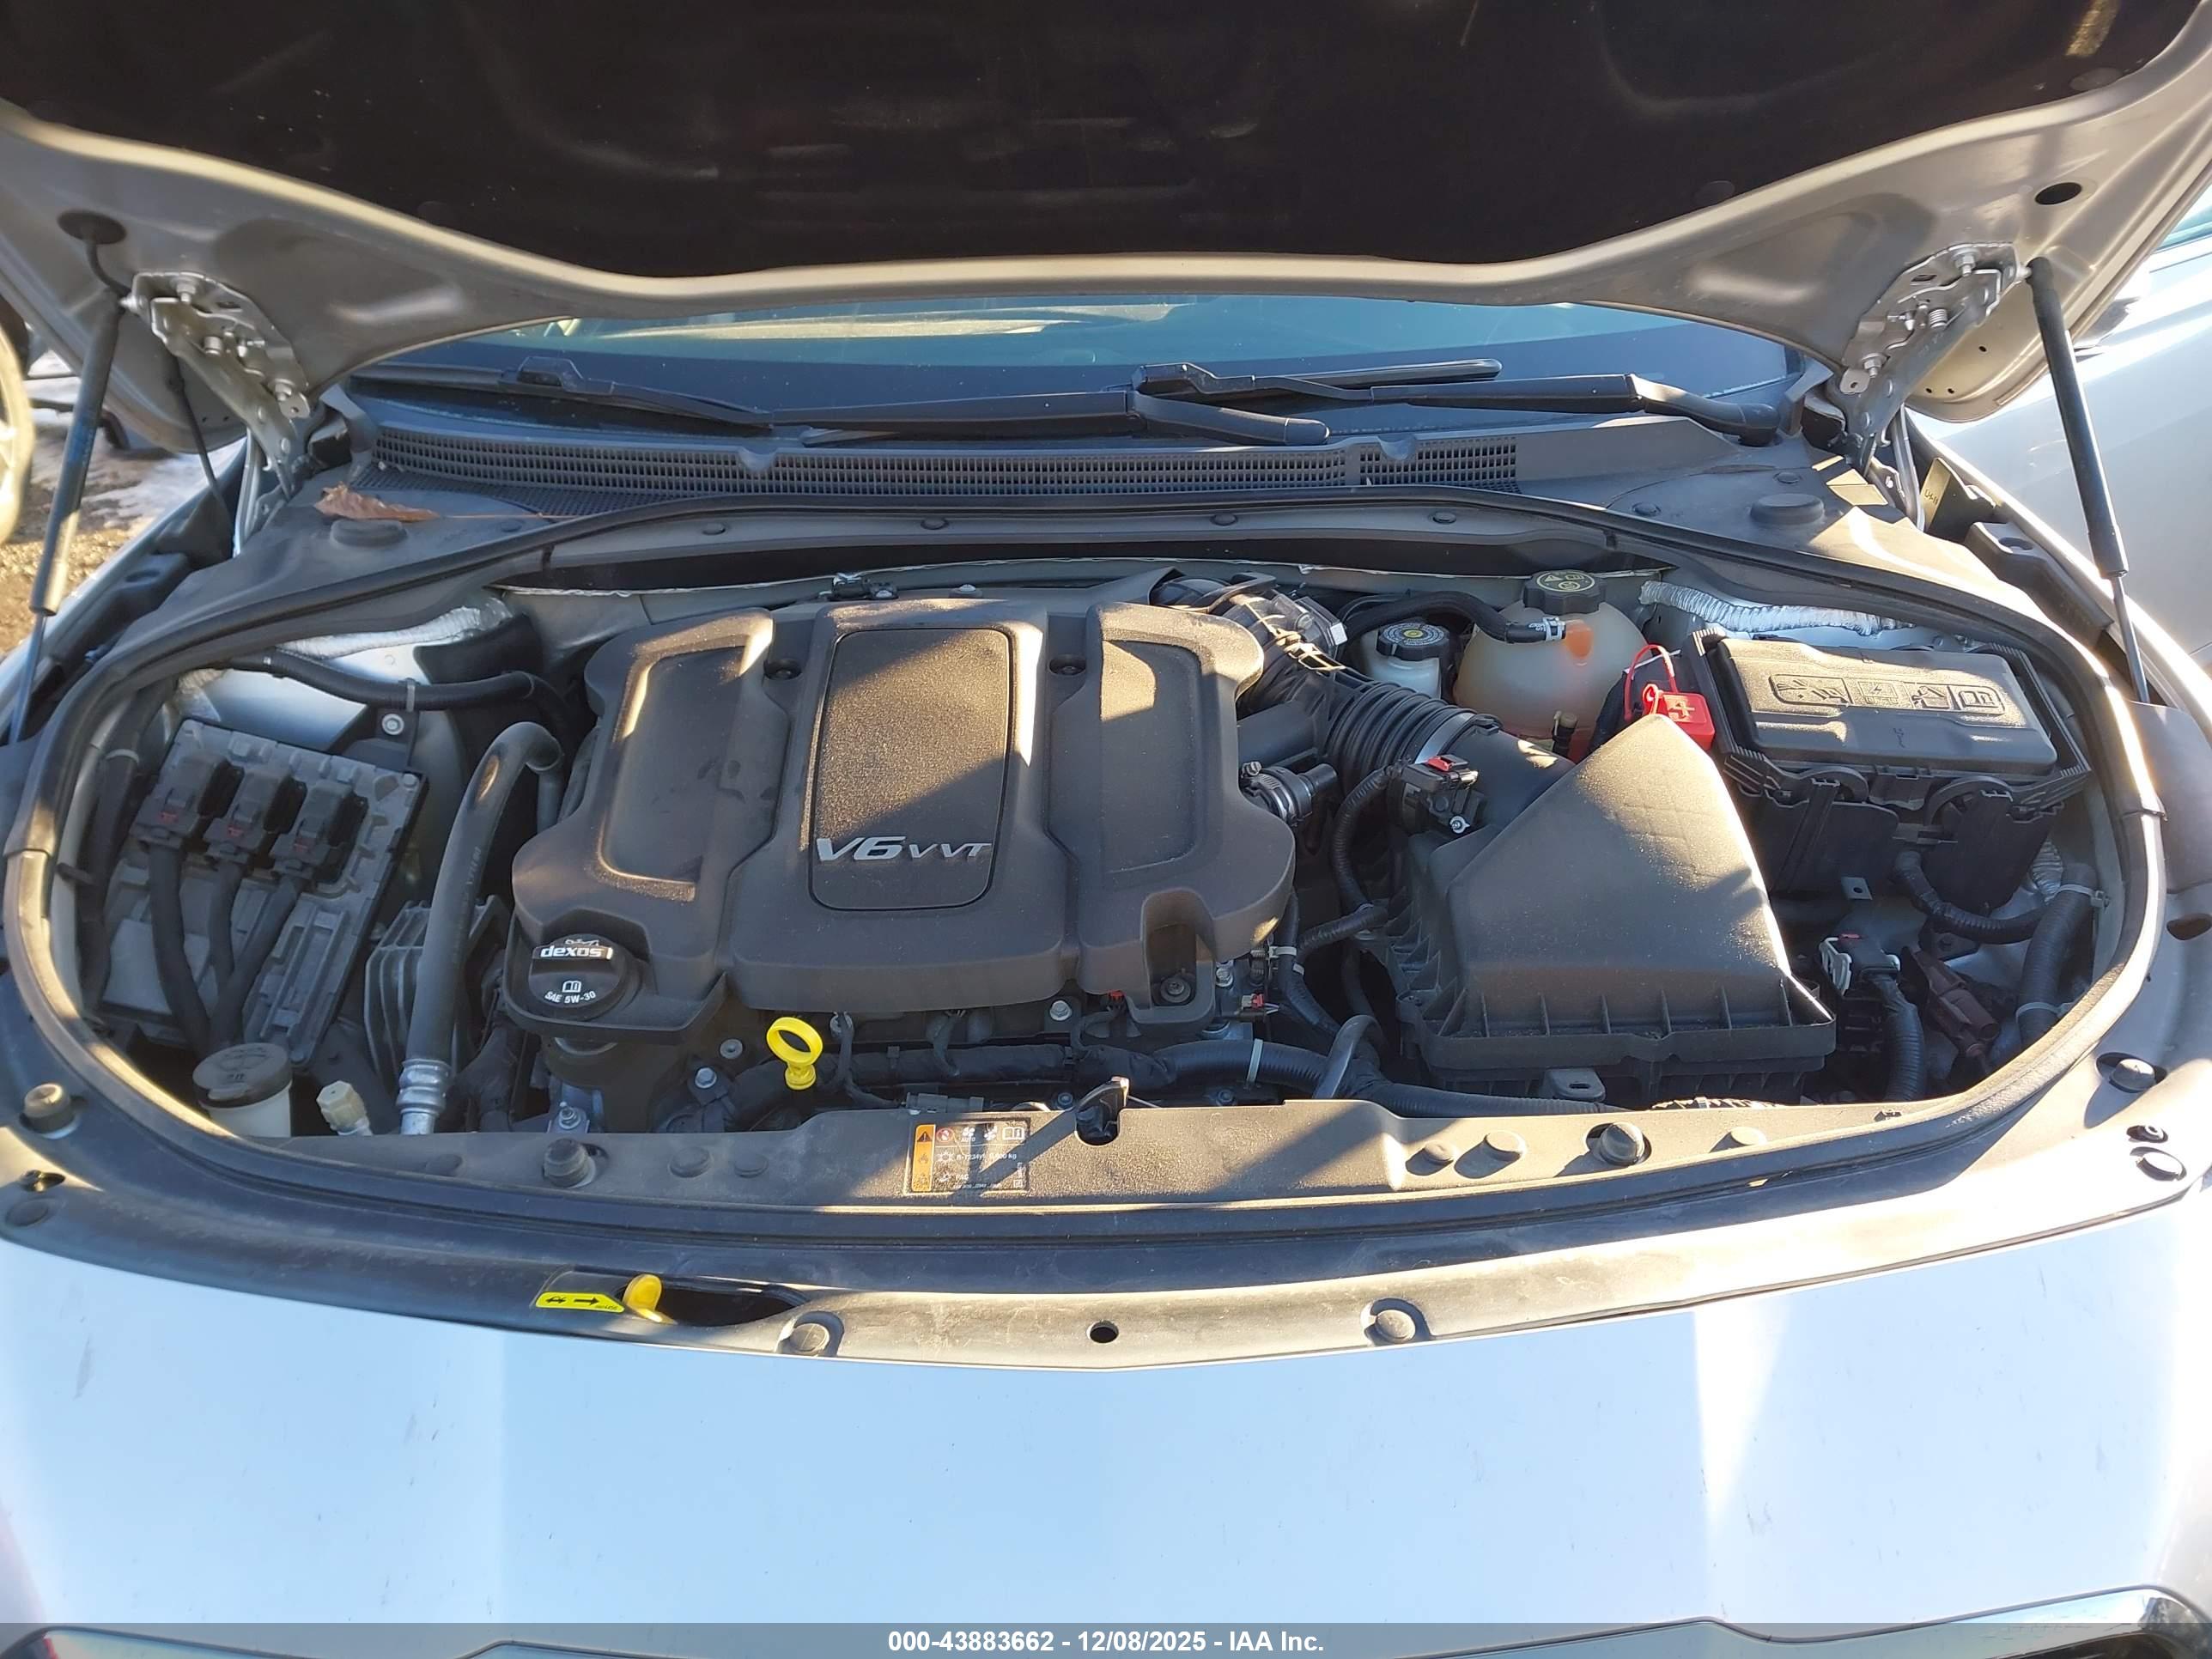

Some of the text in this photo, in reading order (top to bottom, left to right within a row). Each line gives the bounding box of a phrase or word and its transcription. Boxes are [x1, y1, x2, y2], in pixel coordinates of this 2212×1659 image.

[817, 836, 992, 861] V6 VVT
[540, 945, 605, 957] dexos
[544, 990, 596, 1004] SAE 5W-30
